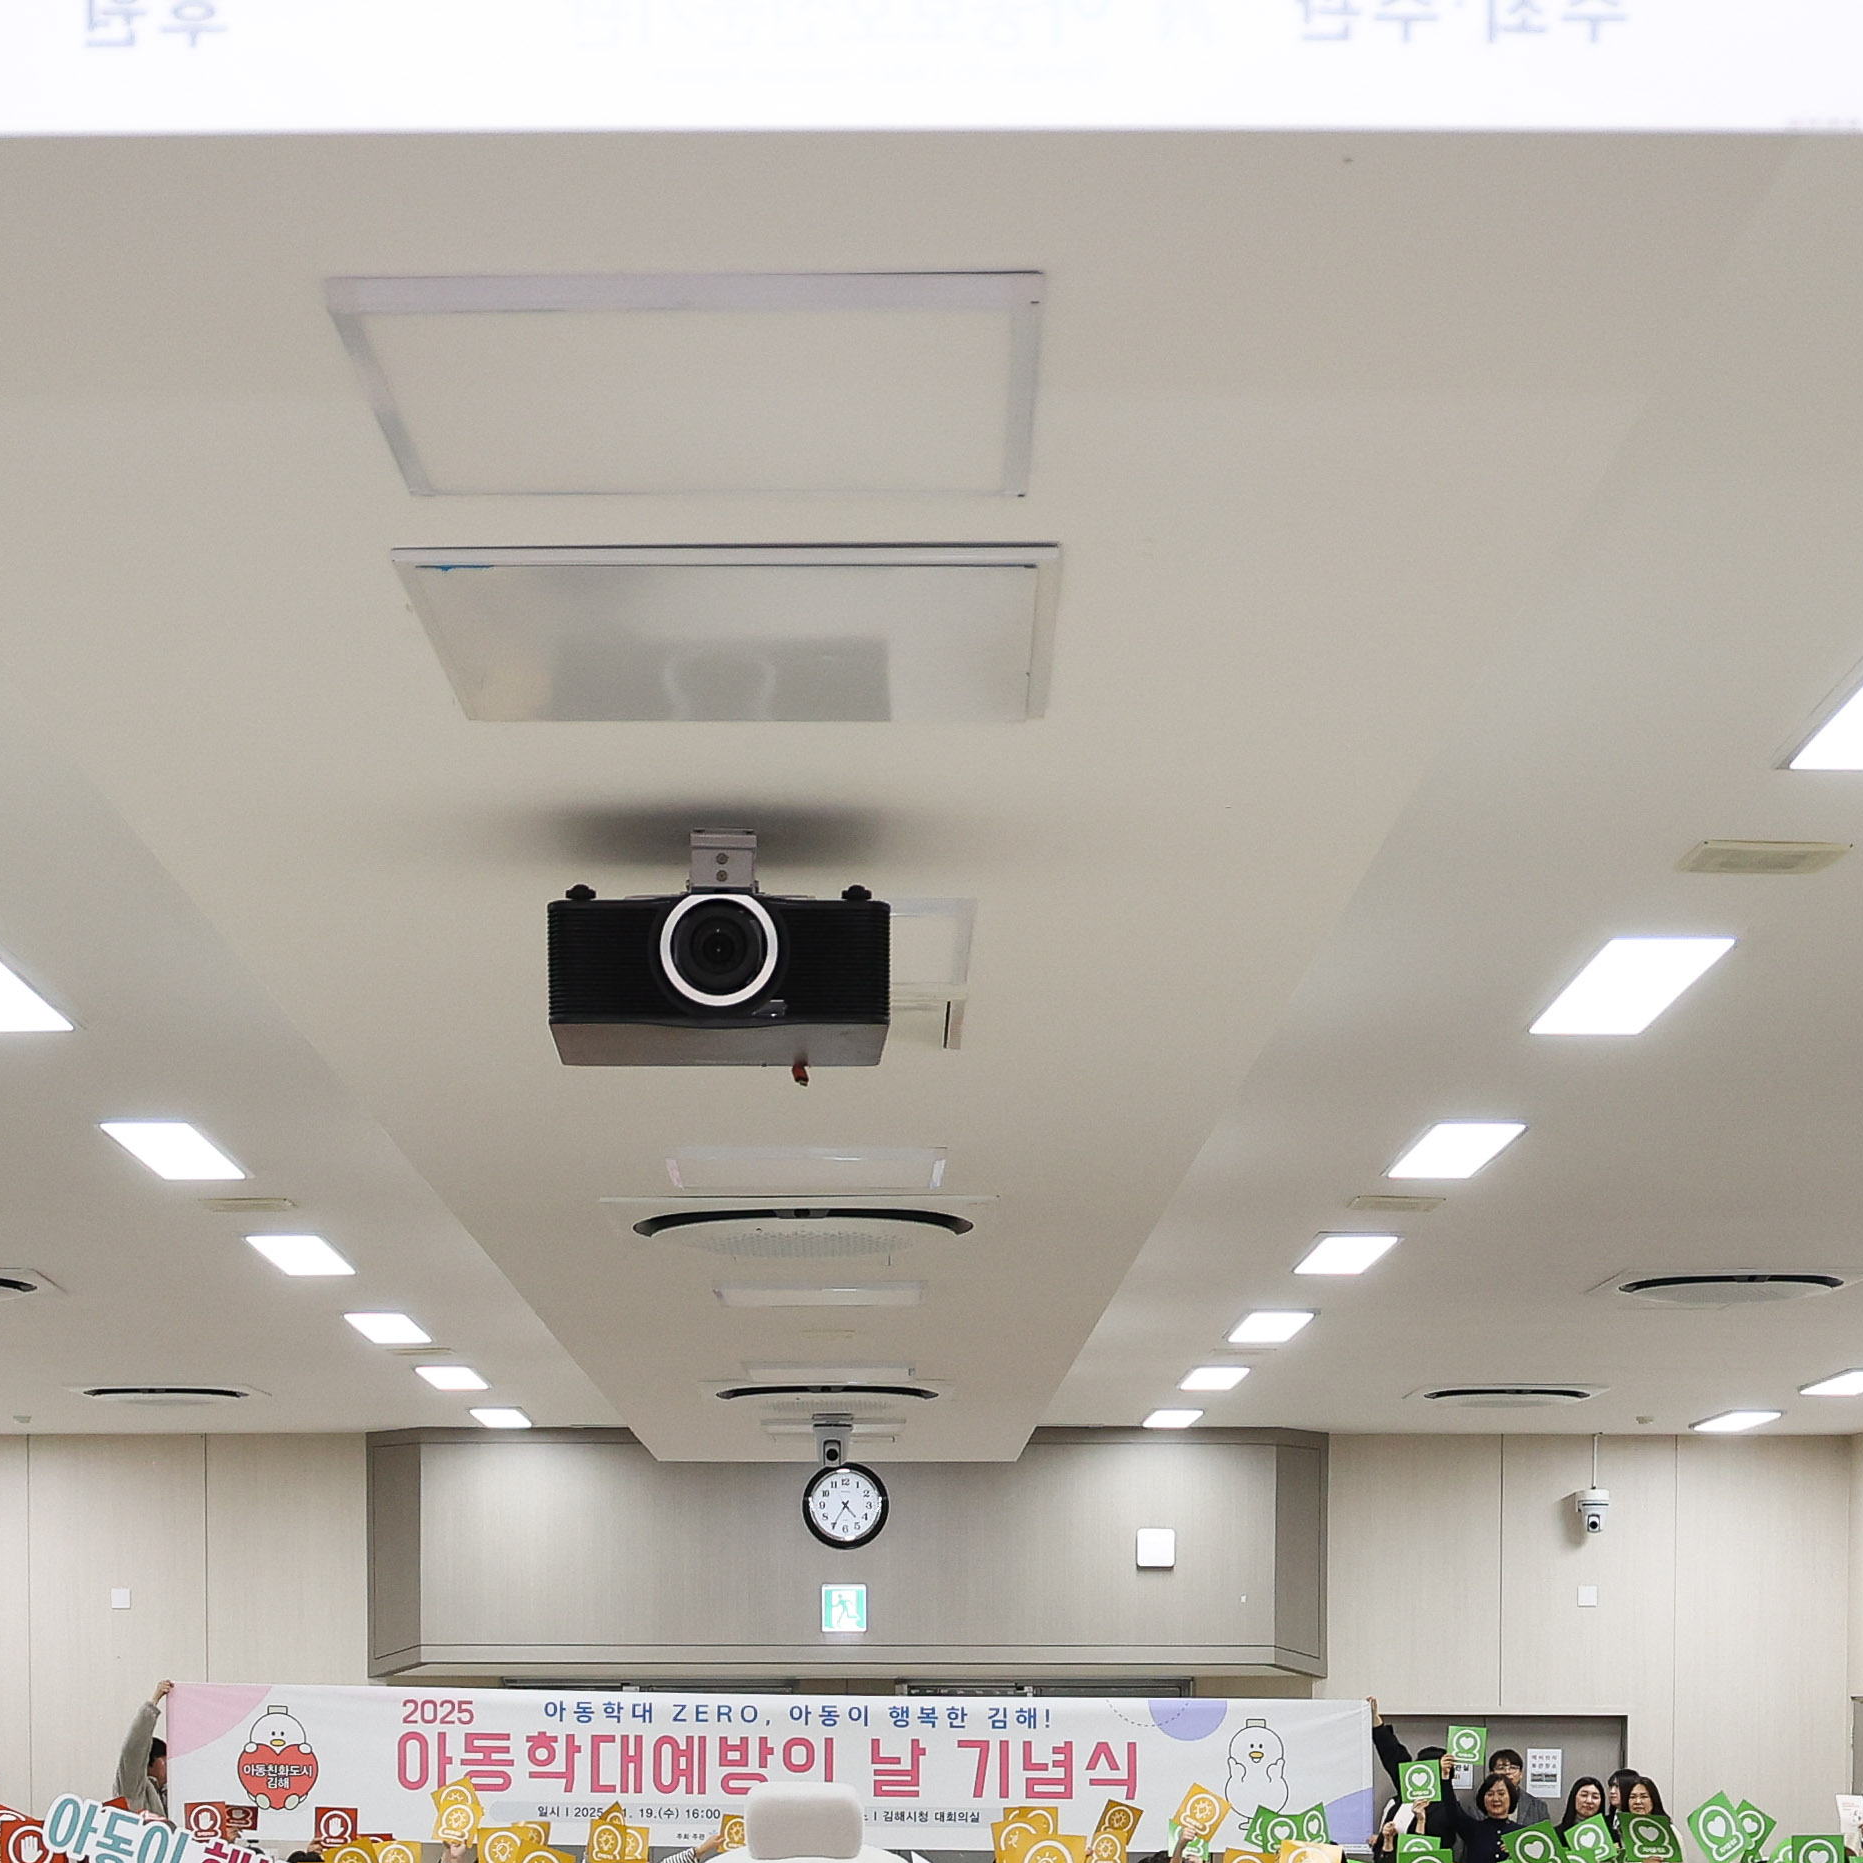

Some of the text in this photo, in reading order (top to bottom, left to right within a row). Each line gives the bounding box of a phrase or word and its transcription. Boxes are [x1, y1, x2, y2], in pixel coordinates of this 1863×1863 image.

[402, 1699, 475, 1725] 2025
[544, 1702, 1051, 1730] 아동학대 ZERO, 아동이 행복한 김해!
[243, 1763, 312, 1778] 아동친화도시
[871, 1738, 926, 1798] 날
[957, 1739, 1138, 1801] 기념식
[267, 1777, 290, 1789] 김해
[537, 1805, 561, 1819] 일시
[685, 1808, 721, 1820] 16:00
[883, 1811, 980, 1824] 김해시청 대회의실
